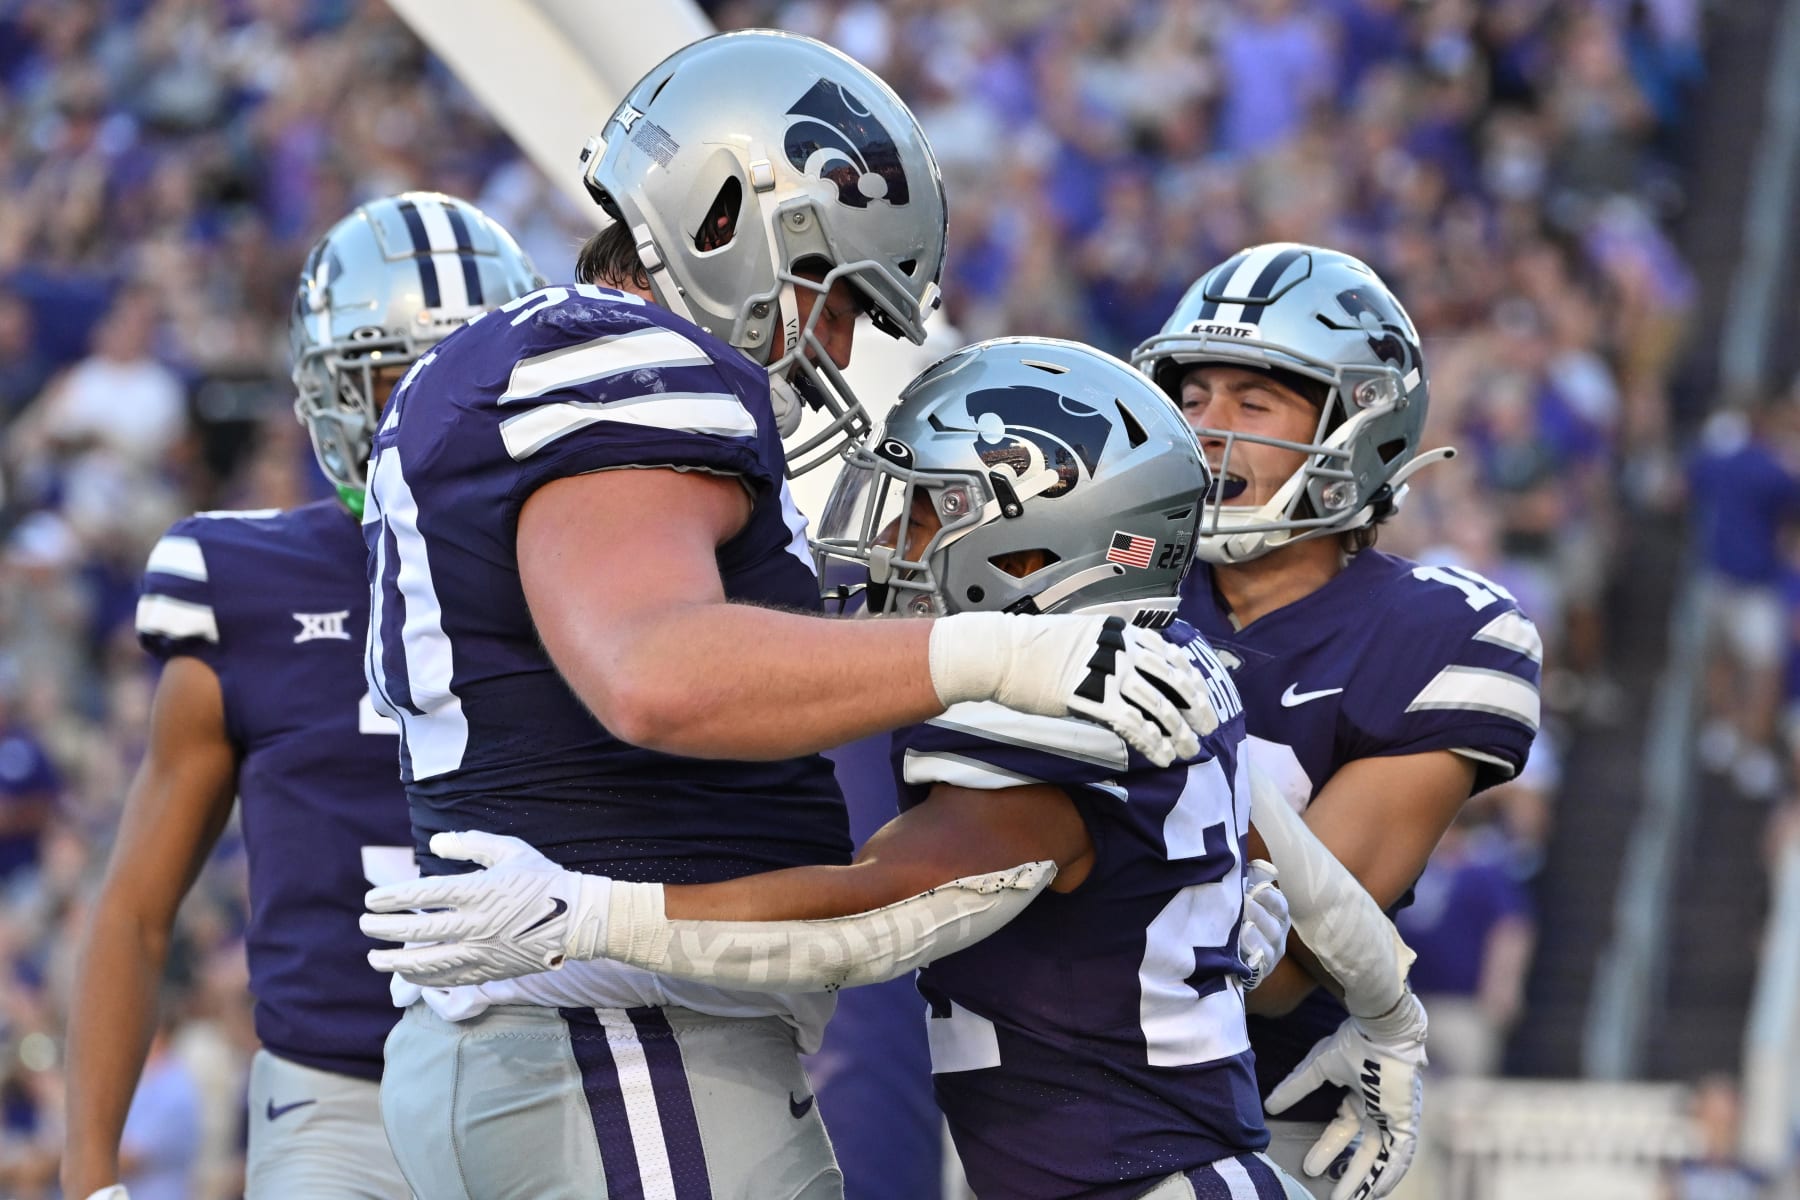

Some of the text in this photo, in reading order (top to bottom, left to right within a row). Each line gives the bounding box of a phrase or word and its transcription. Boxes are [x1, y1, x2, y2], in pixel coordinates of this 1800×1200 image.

[1191, 324, 1253, 338] K-STATE
[1156, 543, 1185, 570] 22
[1138, 738, 1251, 1067] 2
